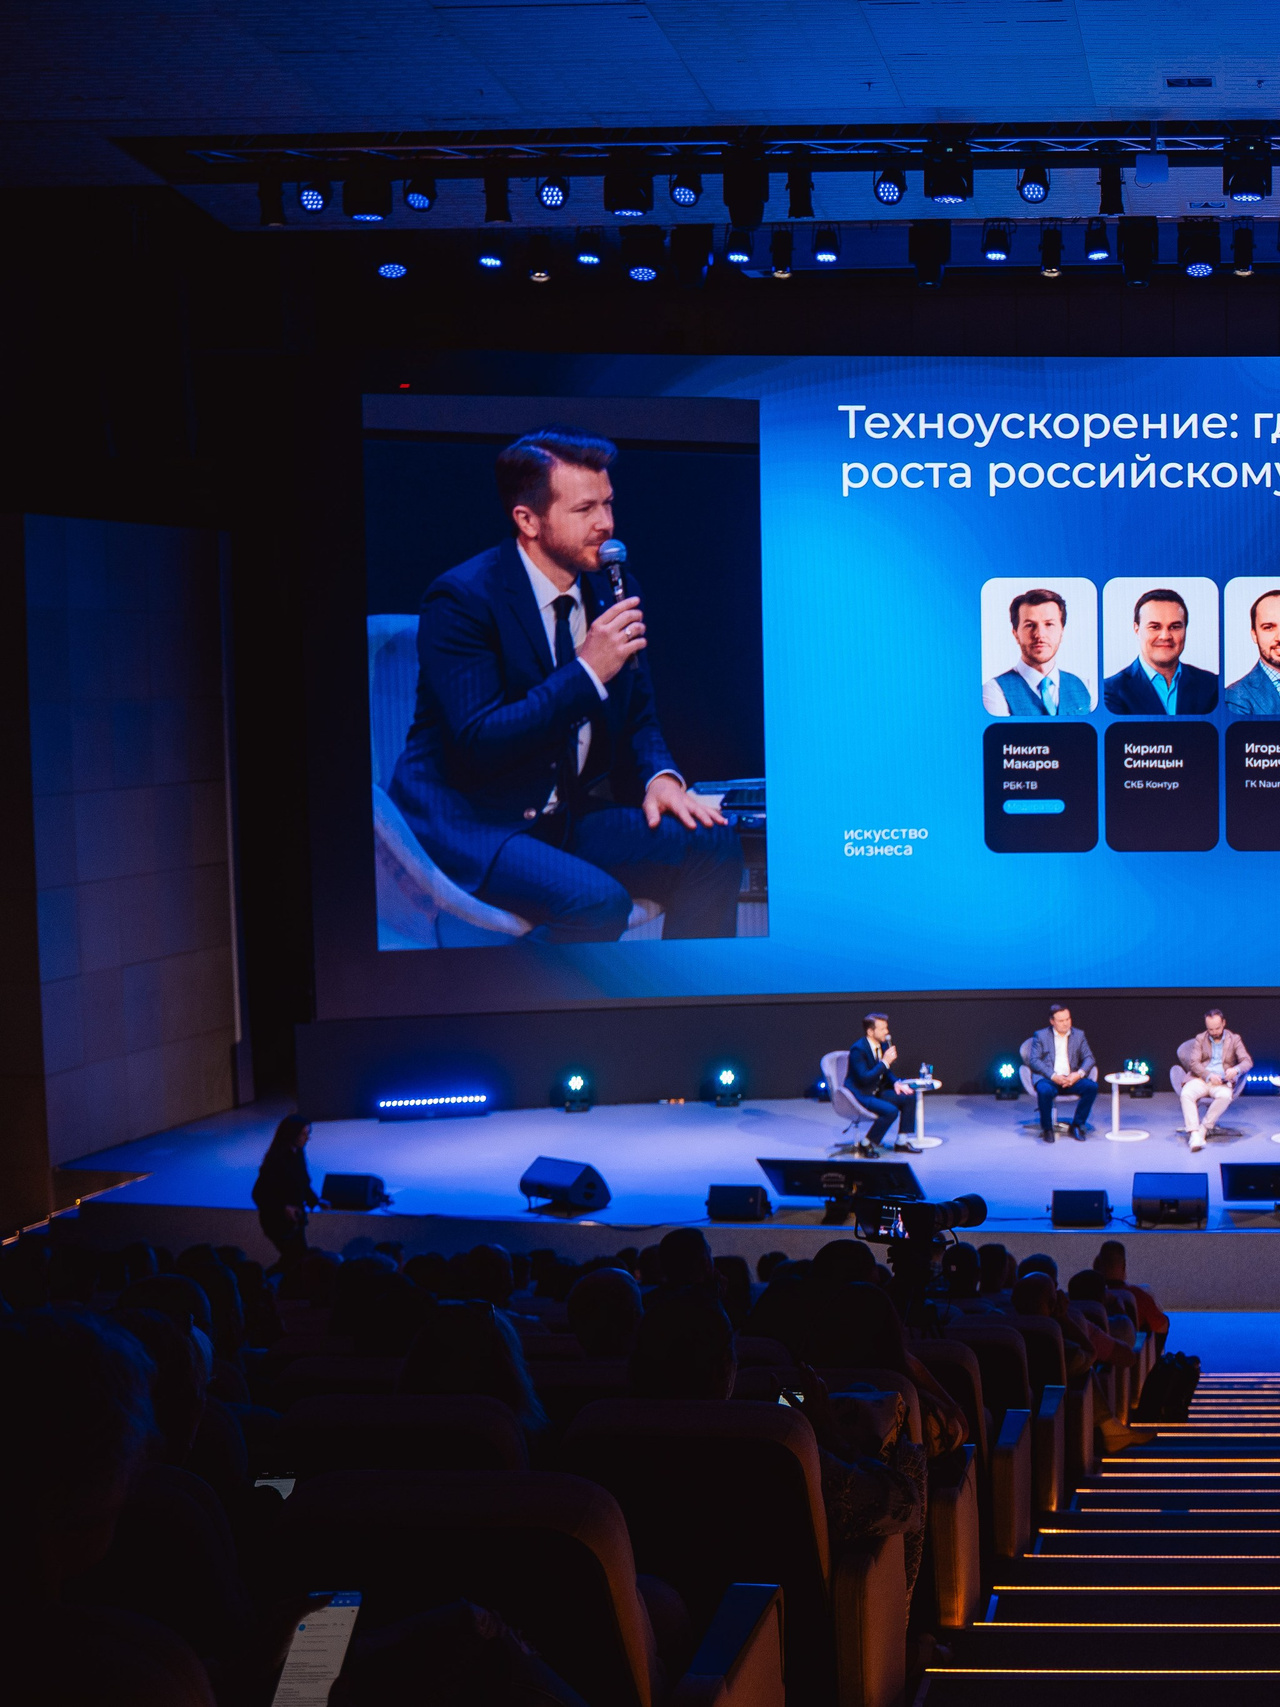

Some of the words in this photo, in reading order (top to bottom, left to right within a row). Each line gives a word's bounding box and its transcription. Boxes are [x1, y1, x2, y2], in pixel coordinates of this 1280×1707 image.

[838, 405, 1238, 447] Техноускорение:
[843, 463, 971, 497] роста
[1003, 744, 1051, 755] Никита
[1124, 743, 1173, 756] Кирилл
[1003, 758, 1060, 771] Макаров
[1123, 757, 1184, 769] Синицын
[1003, 780, 1039, 790] РБК-ТВ
[1124, 780, 1144, 789] СКБ
[1146, 780, 1179, 791] Контур
[1245, 779, 1257, 788] ГК
[844, 828, 929, 842] искусство
[844, 841, 913, 857] бизнеса
